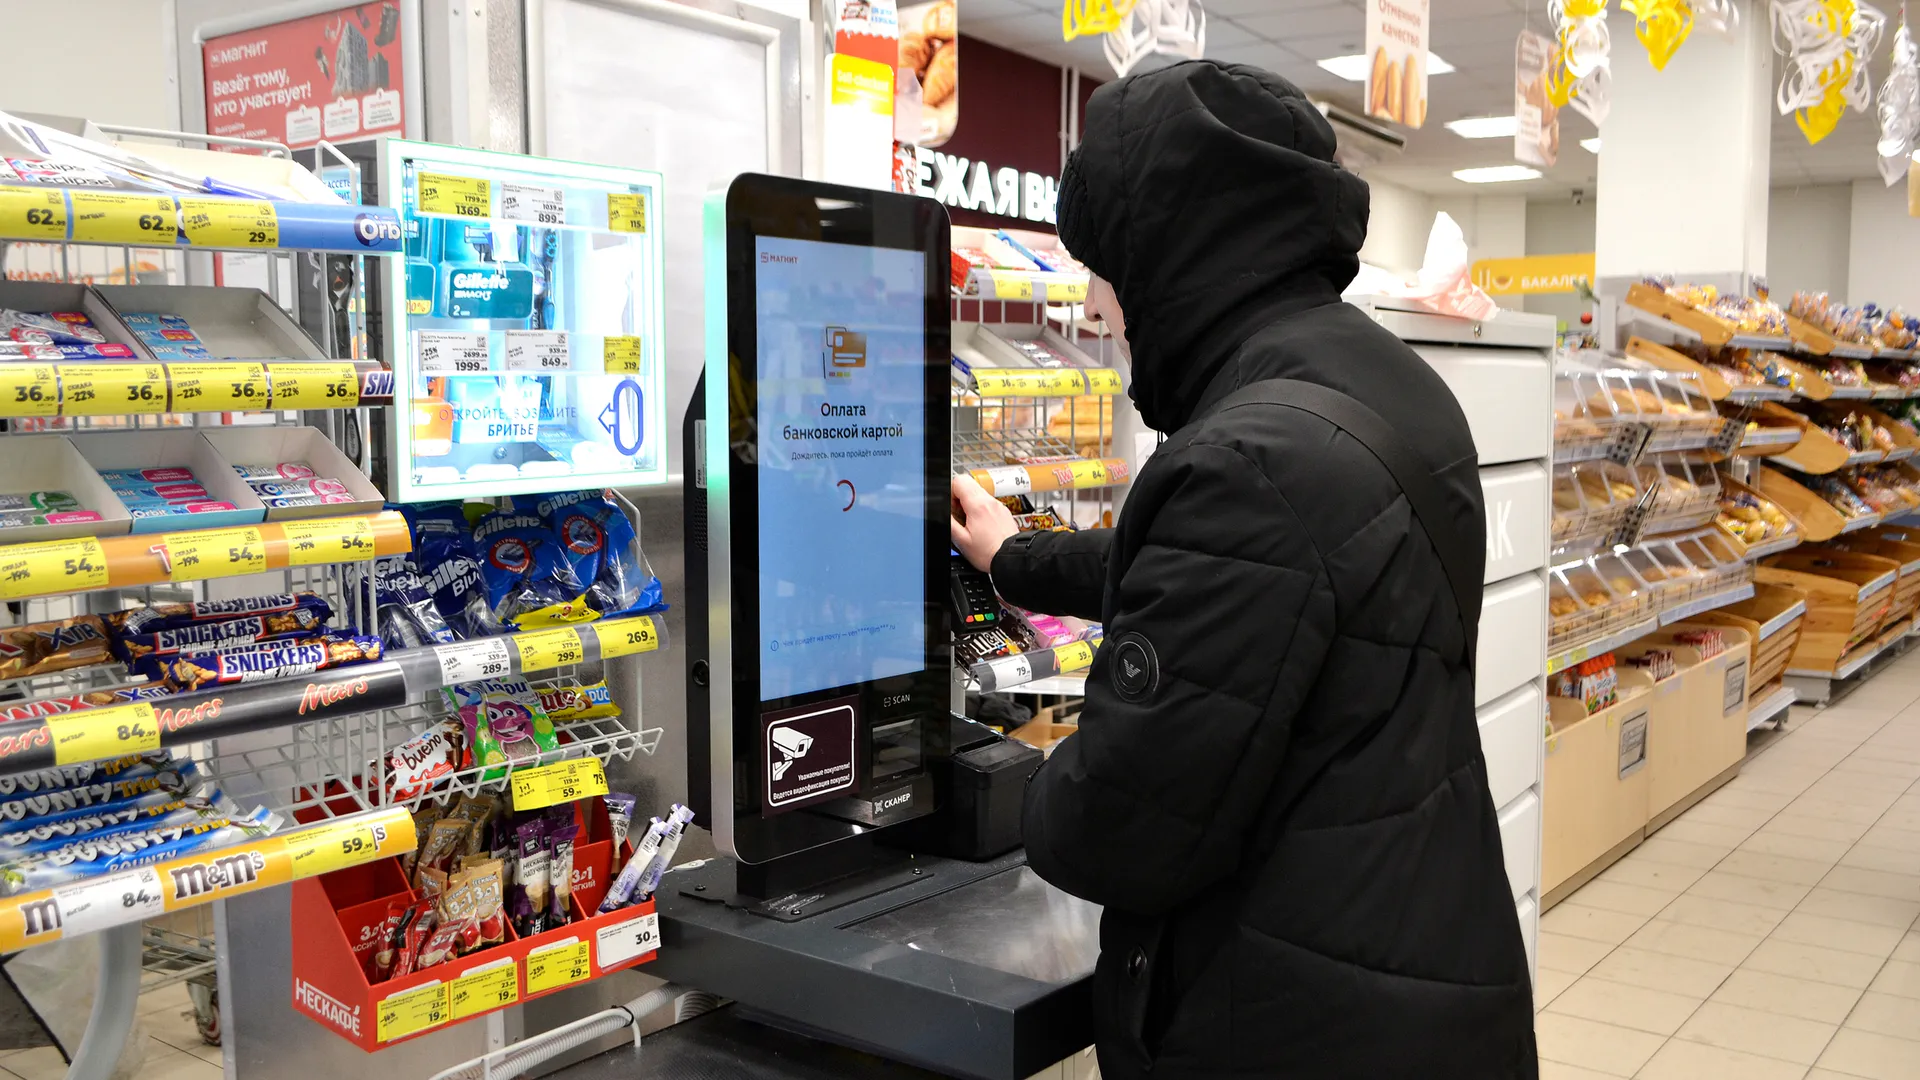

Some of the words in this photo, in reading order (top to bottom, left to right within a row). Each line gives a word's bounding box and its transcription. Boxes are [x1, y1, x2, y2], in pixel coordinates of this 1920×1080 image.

[1381, 21, 1421, 49] качество
[213, 74, 249, 97] Везёт
[254, 68, 290, 87] тому,
[214, 99, 238, 118] кто
[240, 81, 311, 117] участвует!
[39, 176, 111, 186] eclipse
[27, 208, 66, 228] 62.99
[187, 213, 209, 226] -28%
[456, 205, 488, 218] 1369.99
[138, 215, 176, 234] 62.99
[249, 232, 276, 244] 29.99
[769, 253, 798, 265] МАГНИТ
[454, 272, 511, 290] Gillette
[453, 304, 461, 316] 2
[455, 361, 488, 372] 1999.99
[68, 382, 93, 392] СКИДКА
[176, 380, 201, 390] СКИДКА
[231, 383, 265, 399] 36.99
[276, 386, 300, 399] -22%
[326, 383, 357, 399] 36.99
[15, 386, 56, 403] 36.99
[68, 390, 96, 403] -22%
[127, 385, 164, 402] 36.99
[176, 387, 202, 400] -22%
[820, 401, 867, 418] Оплата
[488, 423, 535, 437] БРИТЬЕ
[782, 423, 858, 442] банковской
[860, 422, 903, 442] картой
[830, 450, 845, 460] пока
[873, 448, 893, 458] оплата
[260, 482, 303, 497] Orbit
[537, 488, 604, 517] Gillette
[131, 507, 169, 519] Orbit
[473, 515, 541, 543] Gillette
[294, 539, 315, 552] -19%
[341, 534, 374, 550] 54.99
[175, 548, 198, 559] СКИДКА
[229, 546, 264, 564] 54.99
[64, 557, 105, 576] 54.99
[177, 556, 200, 568] -19%
[4, 569, 31, 583] -19%
[196, 594, 293, 615] SNICKERS
[159, 617, 262, 649] SNICKERS
[825, 633, 841, 643] почту
[224, 644, 322, 676] SNICKERS
[443, 656, 458, 668] -14%
[298, 675, 369, 716] Mars
[892, 694, 911, 706] SCAN
[117, 723, 156, 741] 84.99
[401, 734, 442, 770] bueno
[103, 754, 143, 776] Trio
[798, 769, 824, 782] Уважаемые
[824, 761, 851, 776] покупатели!
[519, 782, 531, 793] 1+1
[562, 788, 582, 799] 59.99
[773, 789, 793, 801] Ведется
[793, 779, 830, 795] видеофиксация
[830, 773, 850, 786] покупок!
[0, 781, 113, 821] OUNTY
[117, 775, 160, 799] Trio
[883, 793, 911, 810] СКАНЕР
[8, 807, 138, 847] BOUNTY
[146, 799, 187, 818] Trio
[51, 826, 184, 867] BOUNTY
[191, 816, 231, 836] Trio
[342, 837, 373, 855] 59.99
[170, 851, 264, 903] m&m's
[122, 889, 161, 908] 84.99
[498, 990, 517, 1002] 19.99
[428, 1010, 447, 1023] 19.99
